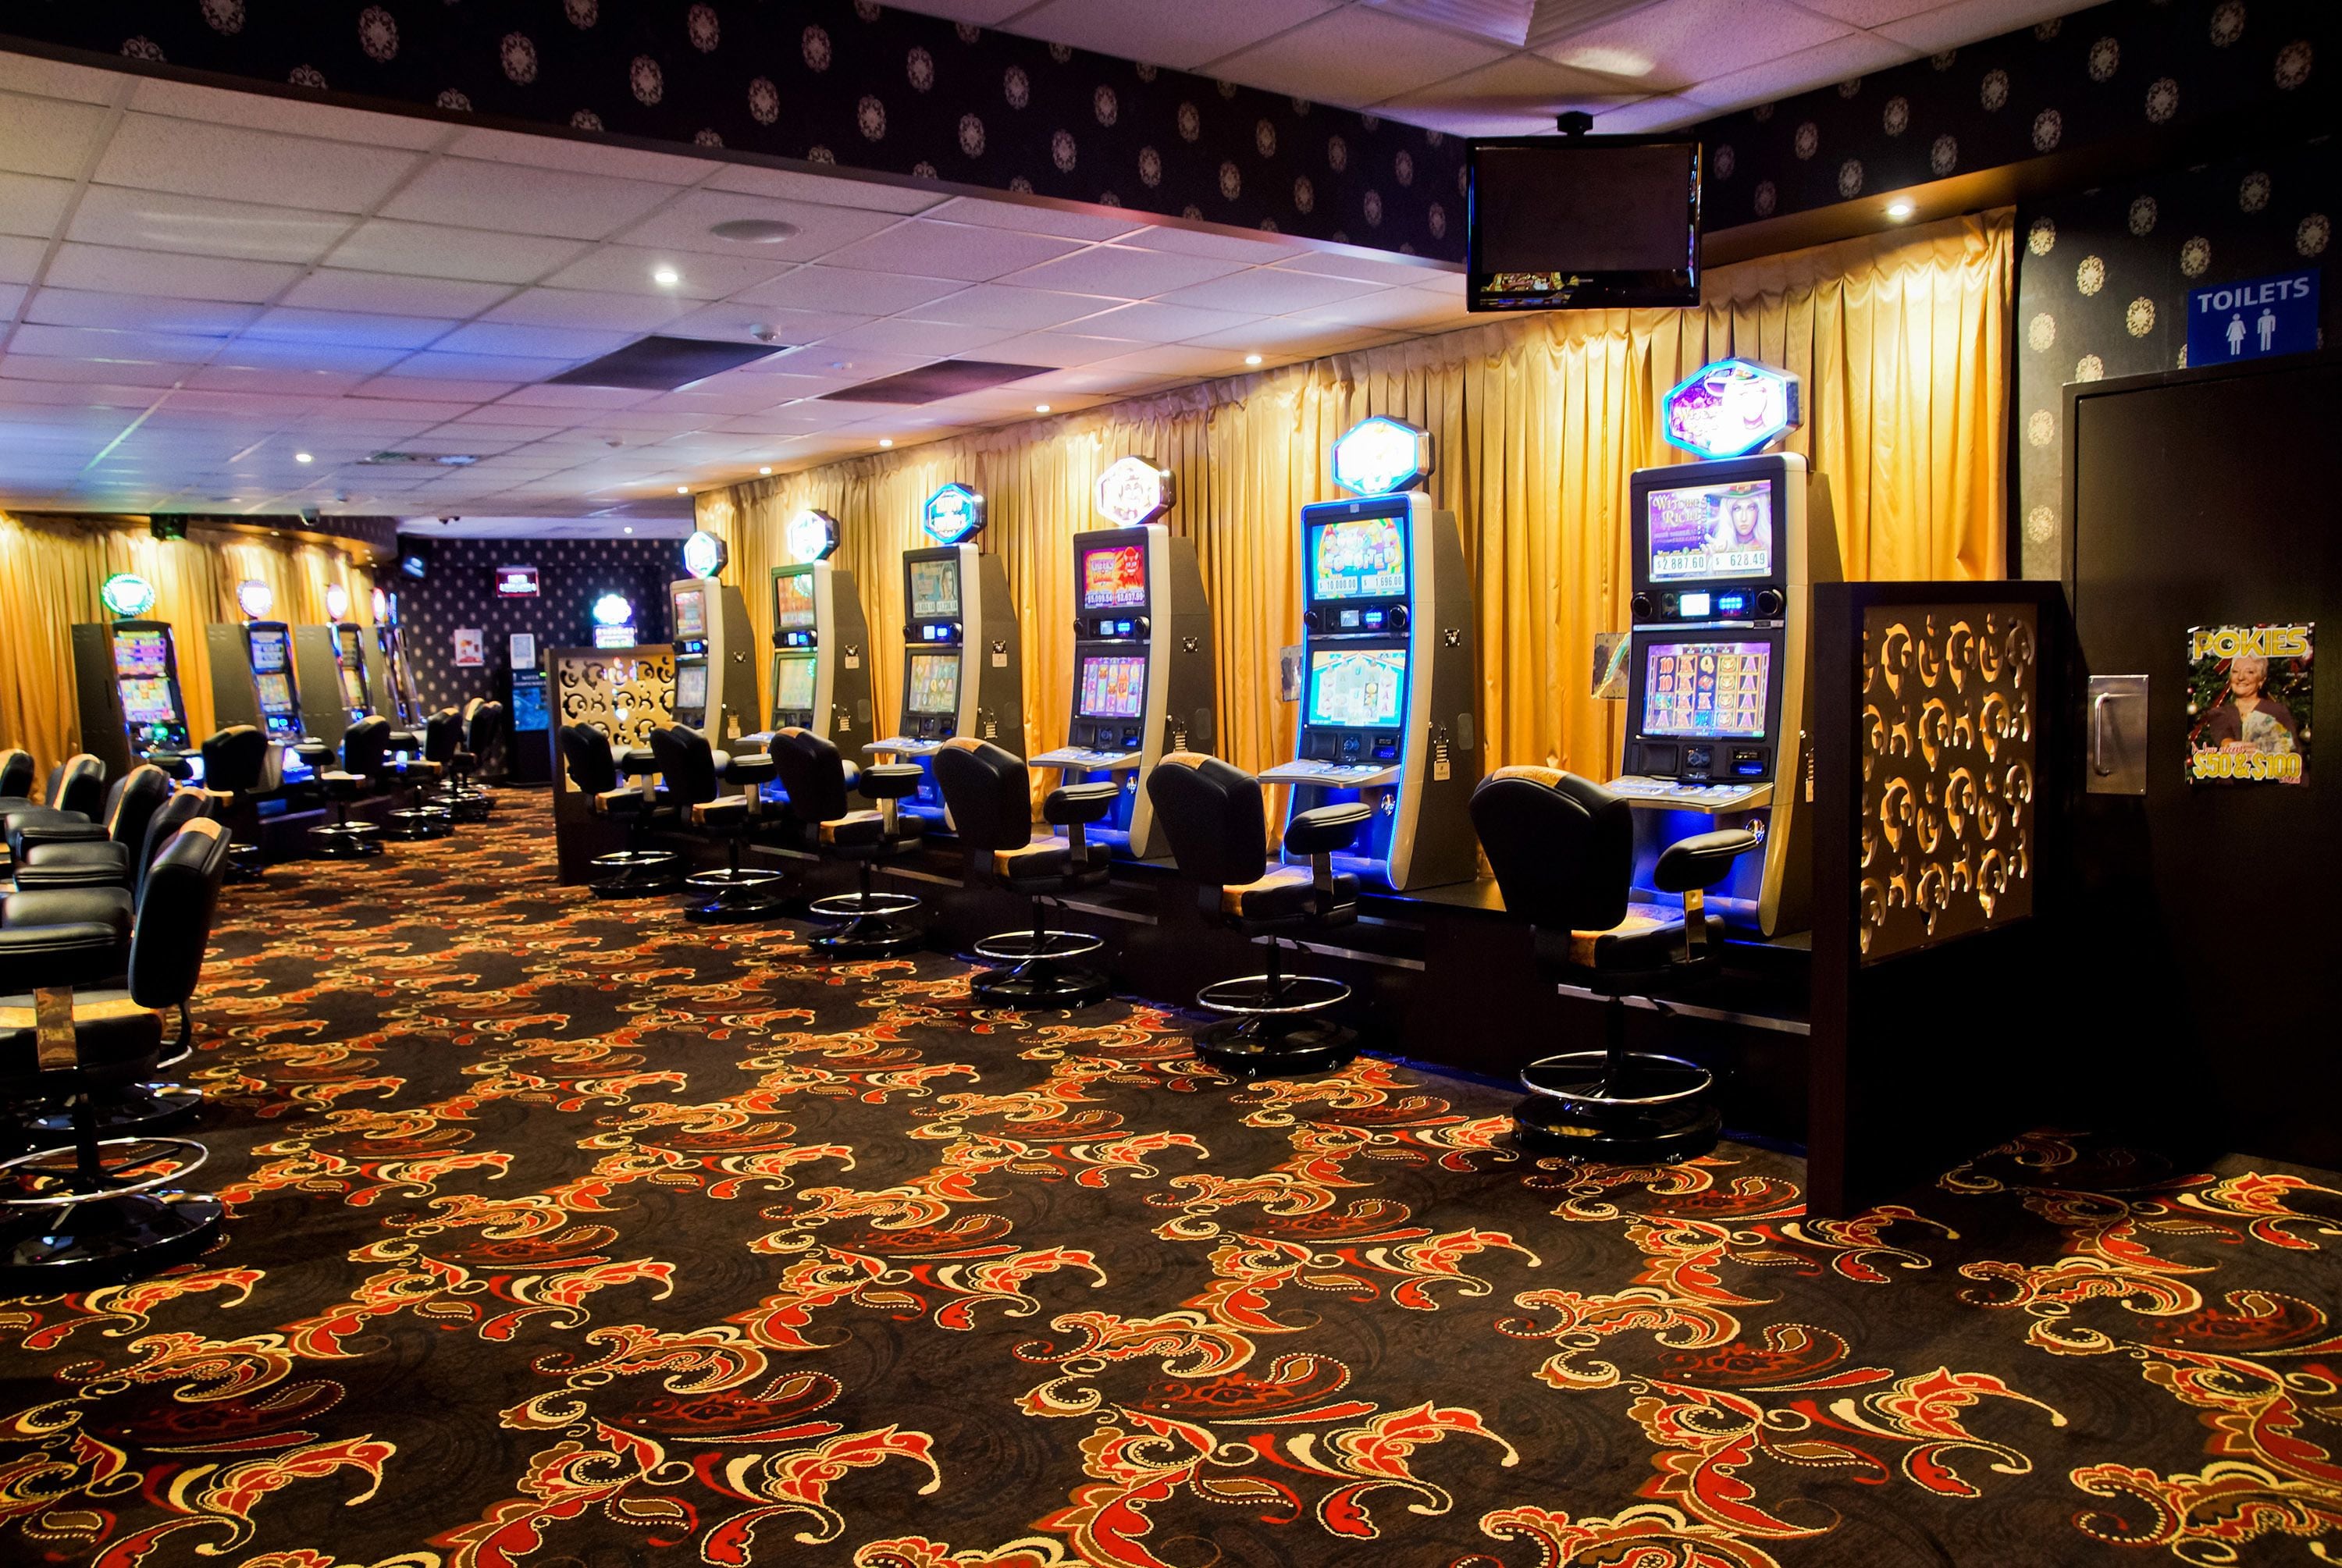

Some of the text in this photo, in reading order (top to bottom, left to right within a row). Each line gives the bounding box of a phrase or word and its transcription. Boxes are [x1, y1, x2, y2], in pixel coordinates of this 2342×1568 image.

[2197, 276, 2310, 314] TOILETS
[2193, 627, 2308, 660] POKIES
[2193, 751, 2302, 780] $50 & $100
